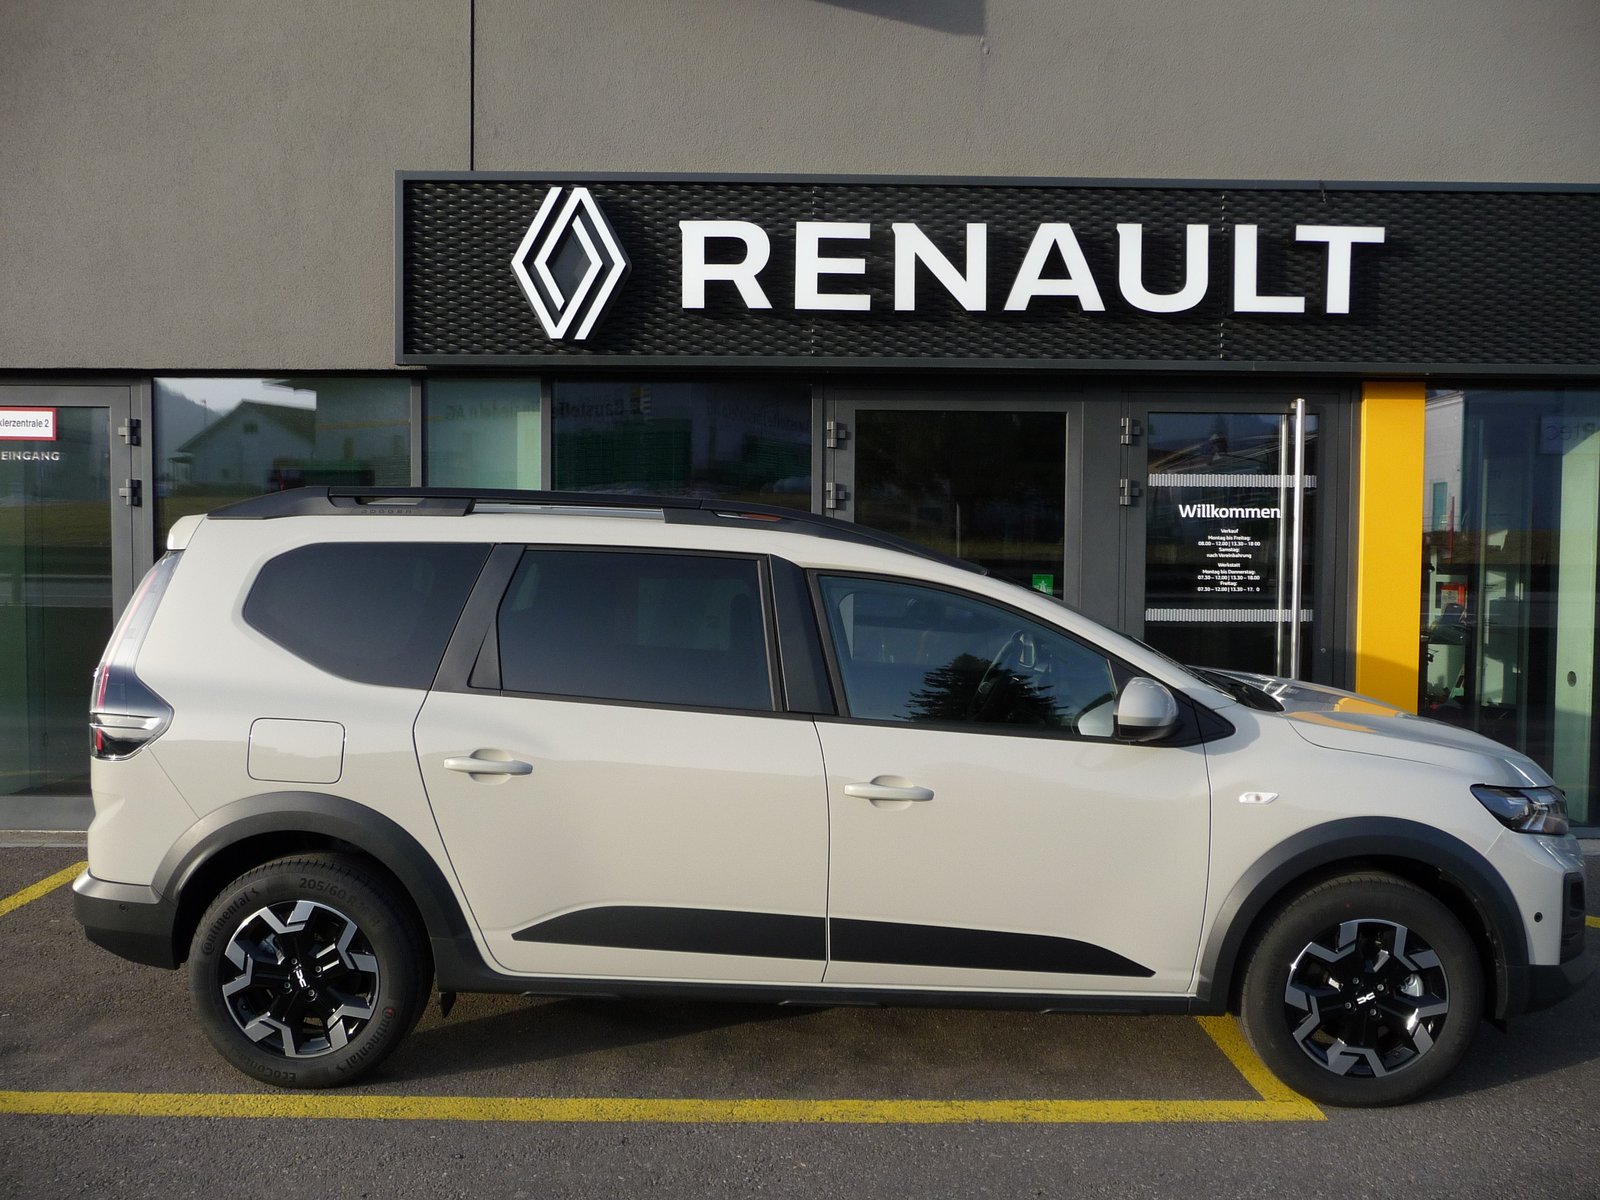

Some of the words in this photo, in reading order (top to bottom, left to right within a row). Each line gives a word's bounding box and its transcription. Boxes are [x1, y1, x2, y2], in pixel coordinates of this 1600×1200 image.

[679, 220, 1386, 315] RENAULT
[44, 419, 49, 428] 2
[1, 451, 60, 461] EINGANG
[1178, 504, 1281, 519] Willkommen
[299, 877, 346, 900] 205/60
[201, 895, 251, 956] Continental
[343, 1007, 397, 1068] Continental
